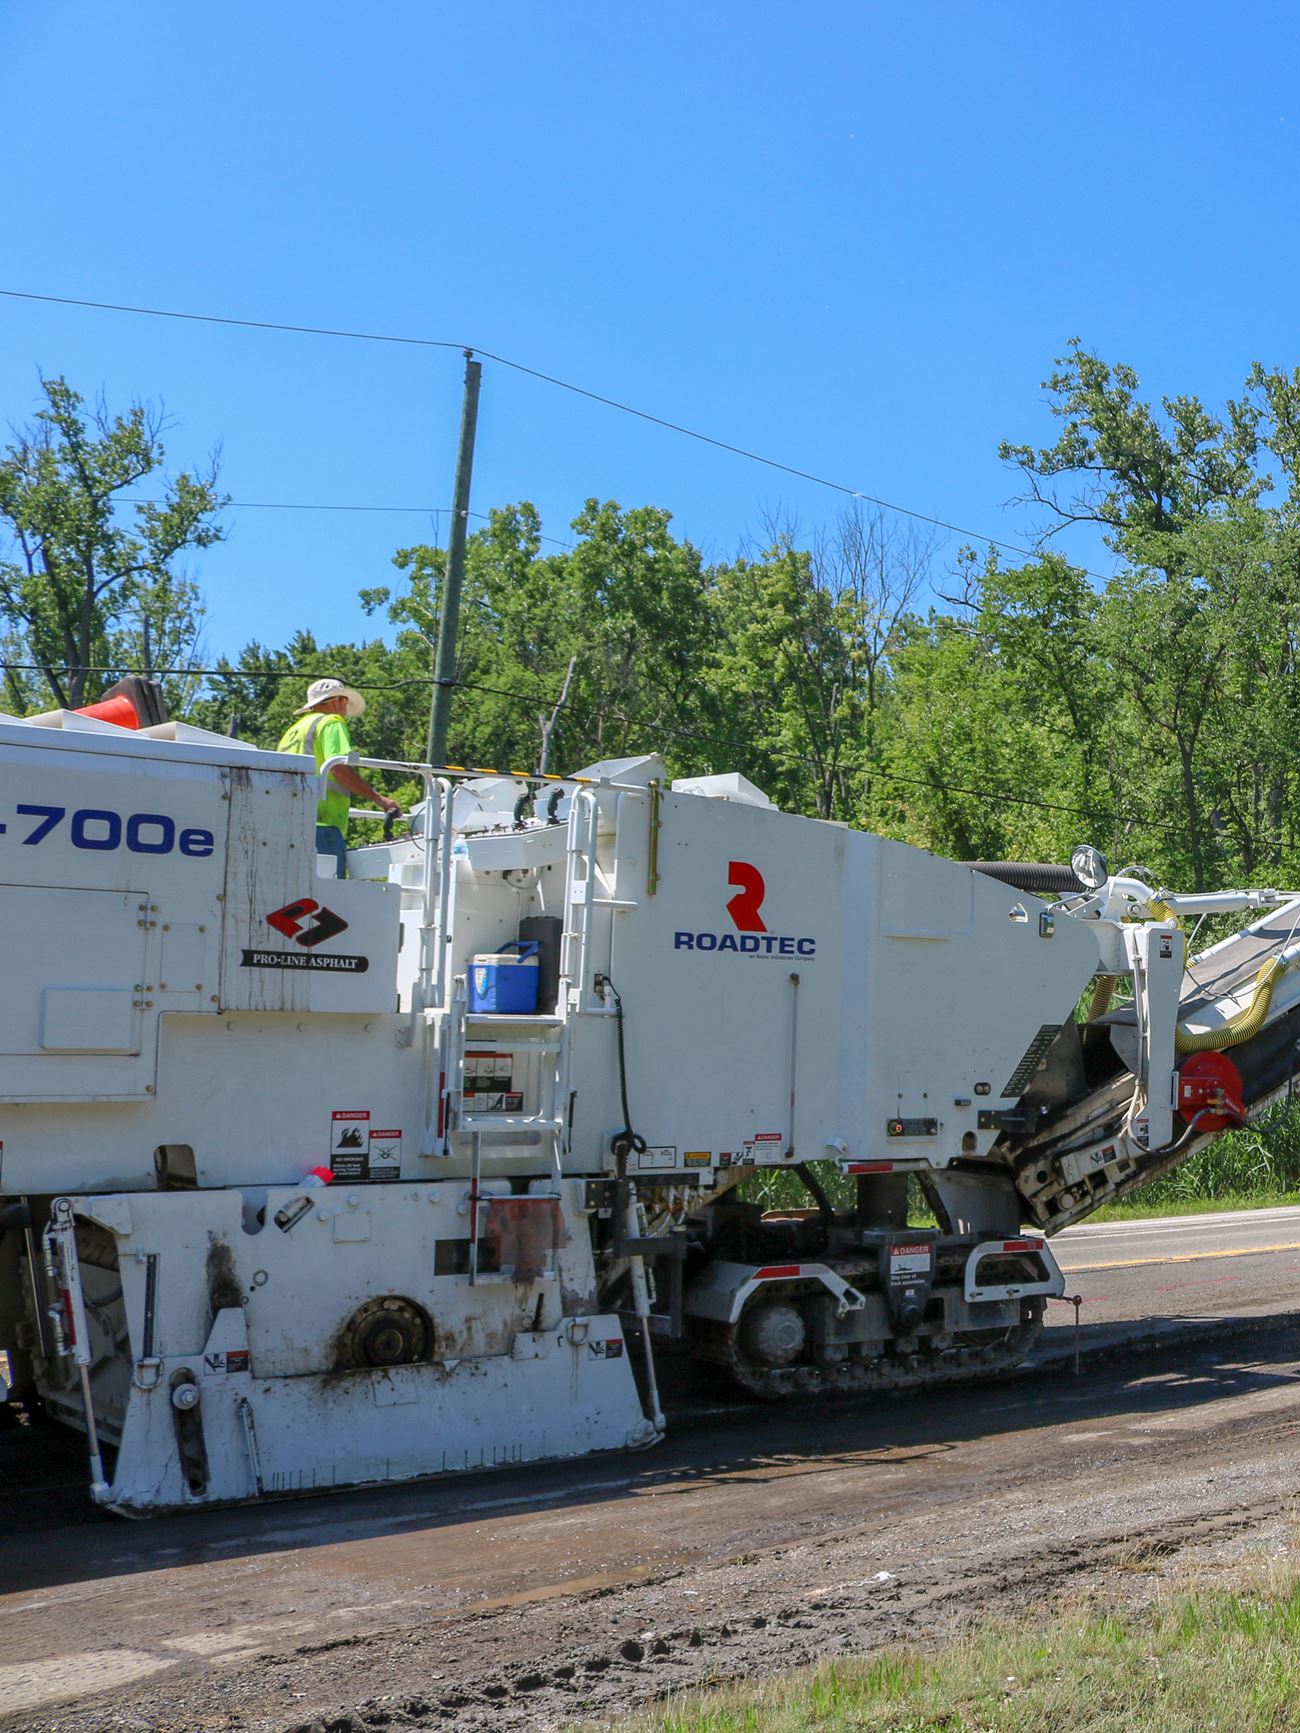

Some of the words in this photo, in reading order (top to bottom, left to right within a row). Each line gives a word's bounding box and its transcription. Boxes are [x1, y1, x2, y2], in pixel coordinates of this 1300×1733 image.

[674, 932, 816, 955] ROADTEC
[253, 954, 307, 966] PRO-LINE
[308, 957, 358, 969] ASPHALT
[900, 1246, 928, 1254] DANGER
